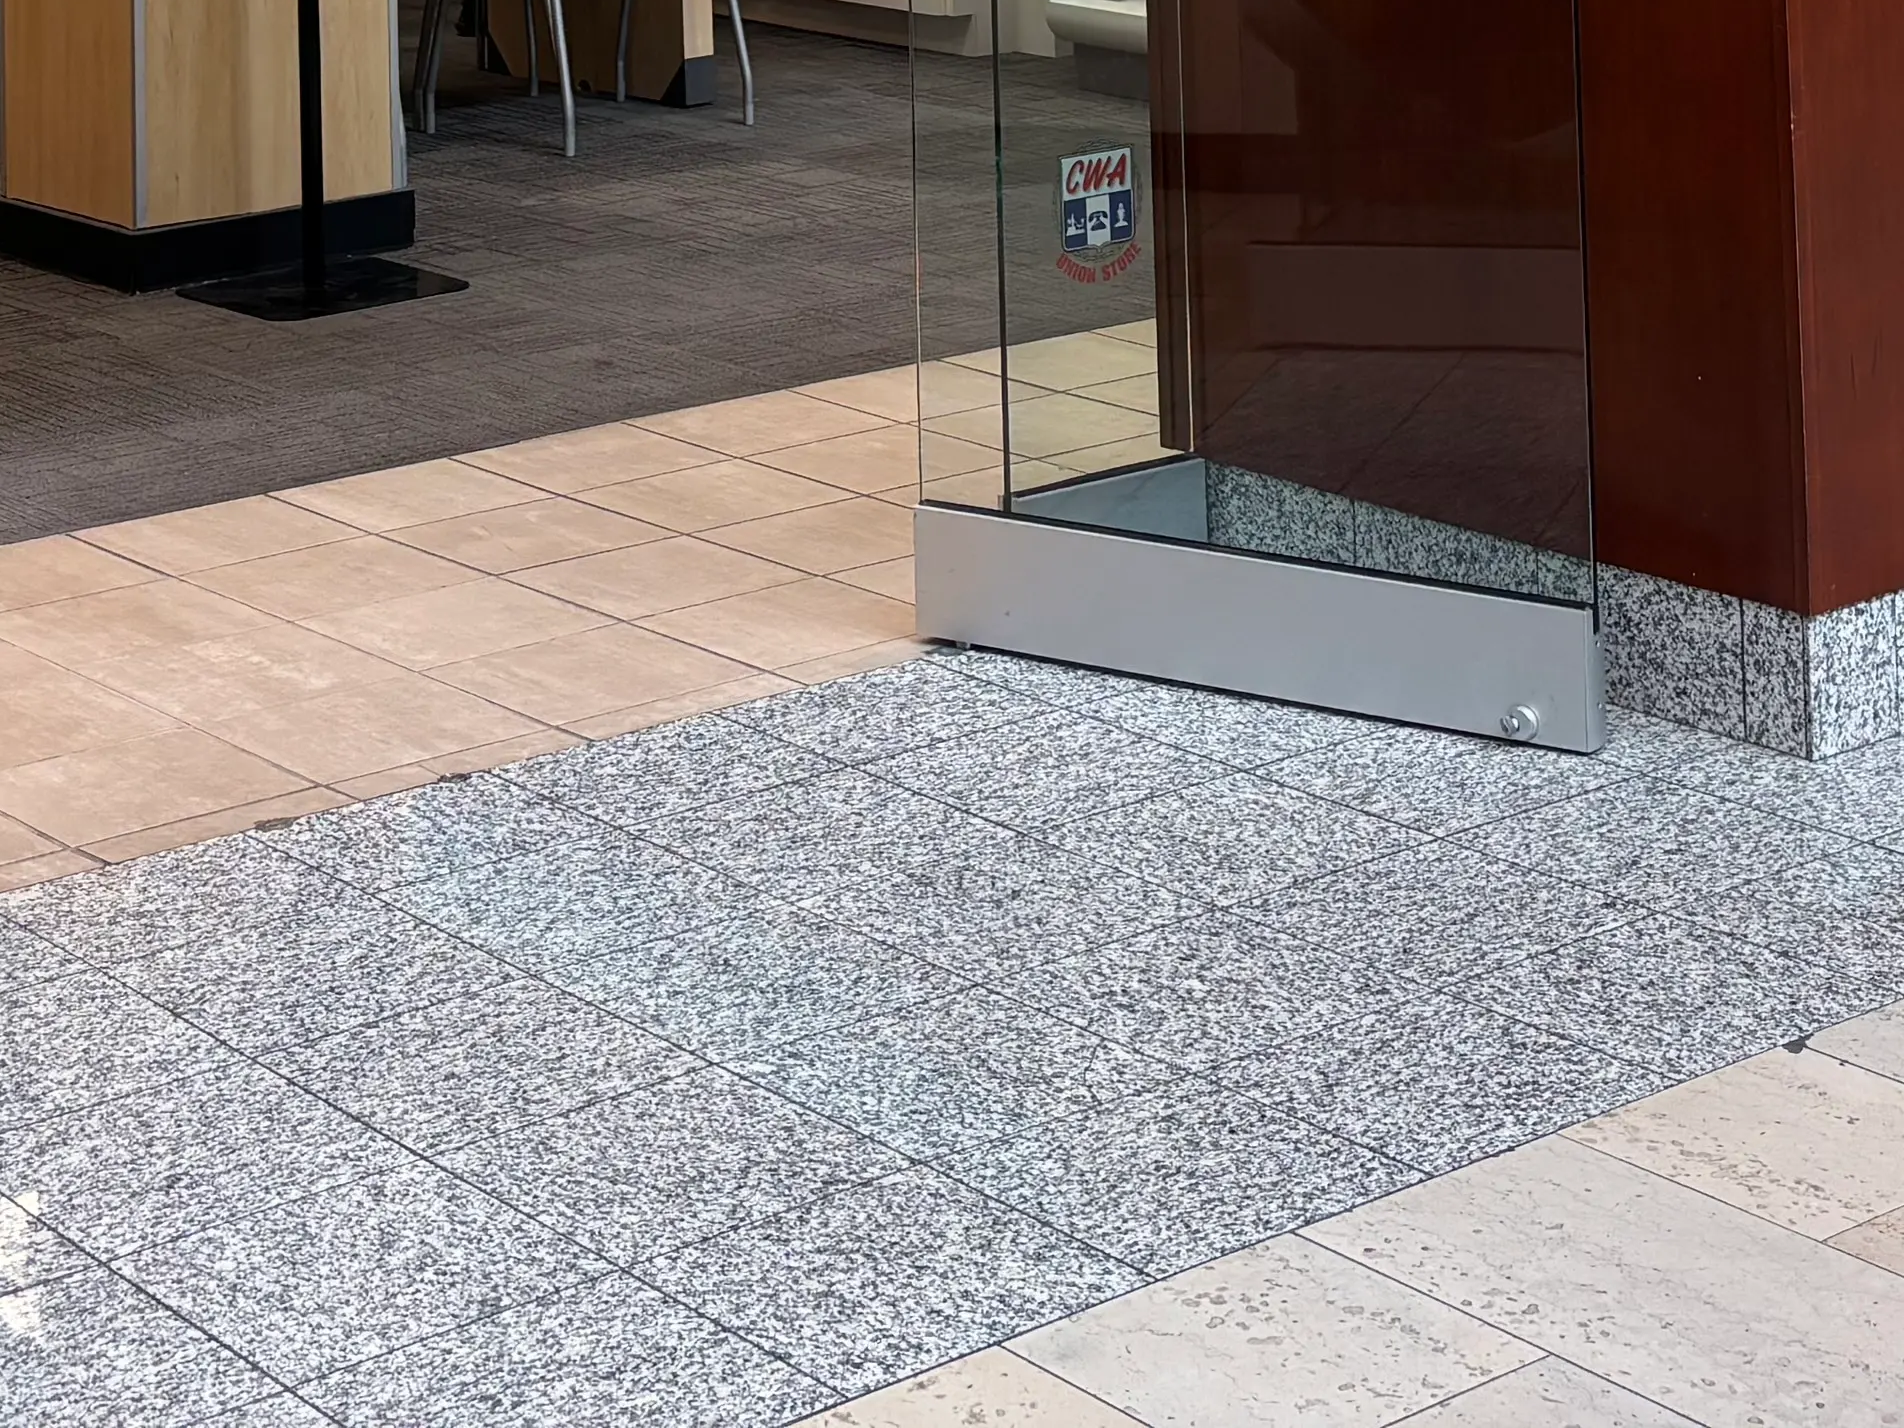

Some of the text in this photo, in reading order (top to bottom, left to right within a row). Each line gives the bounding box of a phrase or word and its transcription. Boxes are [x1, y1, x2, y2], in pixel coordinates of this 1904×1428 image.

[1065, 152, 1127, 196] CWA
[1055, 242, 1143, 284] UNION STORE
